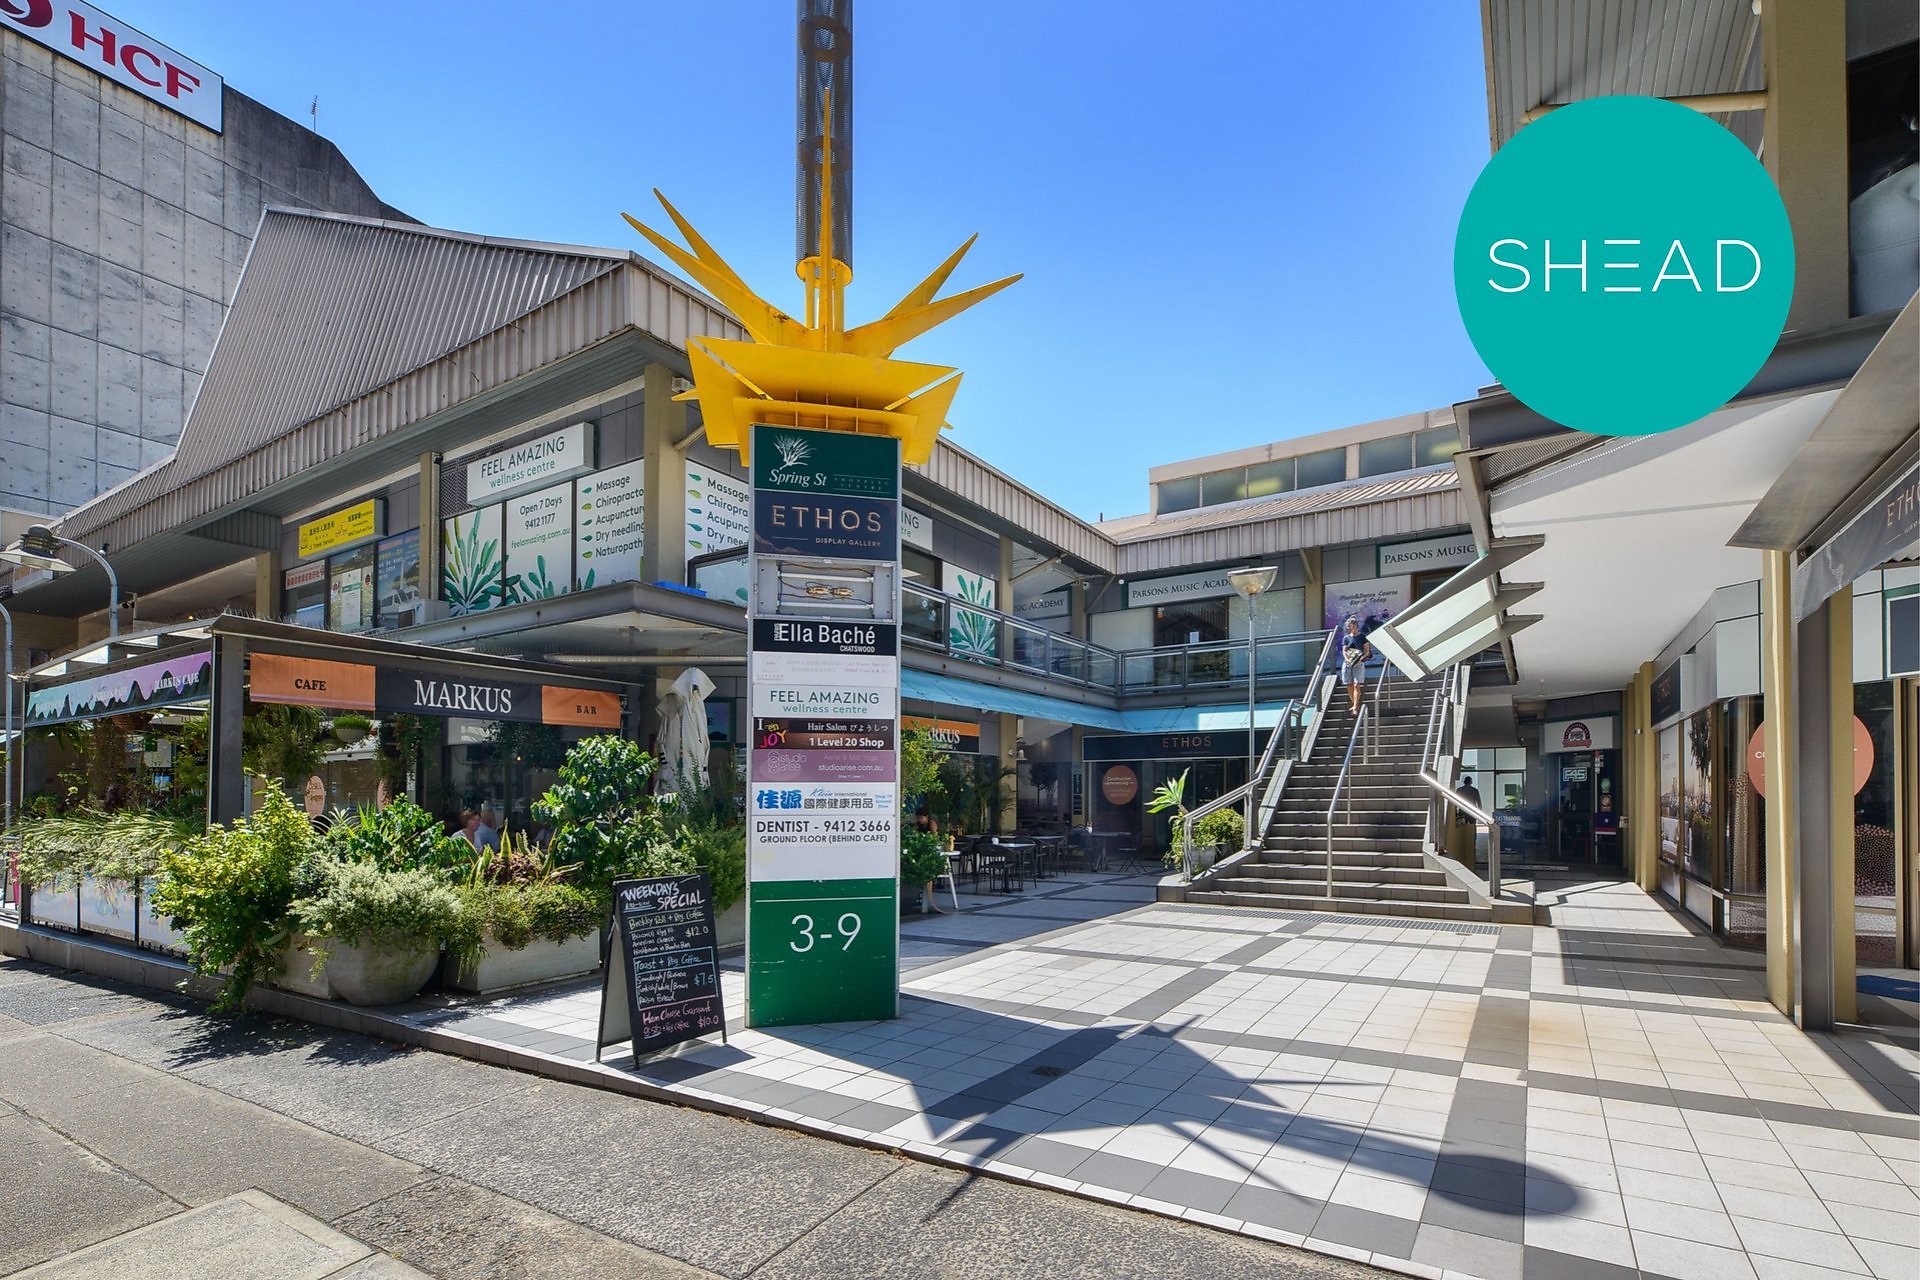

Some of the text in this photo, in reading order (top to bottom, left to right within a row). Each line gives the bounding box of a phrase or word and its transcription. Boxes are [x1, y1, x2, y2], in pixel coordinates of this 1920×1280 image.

[68, 9, 200, 99] HCF
[481, 436, 565, 478] FEEL AMAZING
[489, 459, 555, 488] wellness centre
[769, 469, 827, 488] Spring St
[596, 475, 630, 492] Massage
[707, 477, 749, 502] Massage
[519, 496, 563, 516] Open 7 Days
[707, 494, 748, 517] Chiropra
[525, 512, 556, 529] 9412 1177
[772, 505, 881, 532] ETHOS
[511, 528, 570, 549] feelamazing.com.au
[596, 530, 610, 542] Dry
[707, 527, 725, 543] Dry
[816, 537, 881, 547] DISPLAY GALLERY
[595, 538, 643, 557] Naturopath
[1384, 544, 1475, 564] PARSONS MUSIC
[1132, 578, 1231, 598] PARSONS MUSIC ACAD
[1029, 599, 1064, 610] ACADEMY
[779, 623, 876, 645] Ella Baché
[840, 645, 876, 653] CHATSWOOD
[154, 676, 181, 692] MARKUS
[294, 678, 327, 692] CAFE
[413, 679, 512, 713] MARKUS
[770, 690, 880, 704] FEEL AMAZING
[576, 703, 597, 715] BAR
[783, 704, 868, 714] wellness centre
[807, 722, 847, 731] Hair Salon
[809, 737, 884, 749] 1 Level 20 Shop
[1162, 736, 1212, 748] ETHOS
[756, 789, 802, 809] 佳源
[804, 798, 874, 809] 國際健康用品
[757, 821, 810, 833] DENTIST
[823, 820, 855, 832] 9412
[860, 820, 891, 832] 3666
[760, 834, 888, 844] GROUND FLOOR (BEHIND CAFE)
[657, 889, 706, 911] SPECIAL
[790, 913, 861, 952] 3-9
[635, 959, 656, 972] Toast
